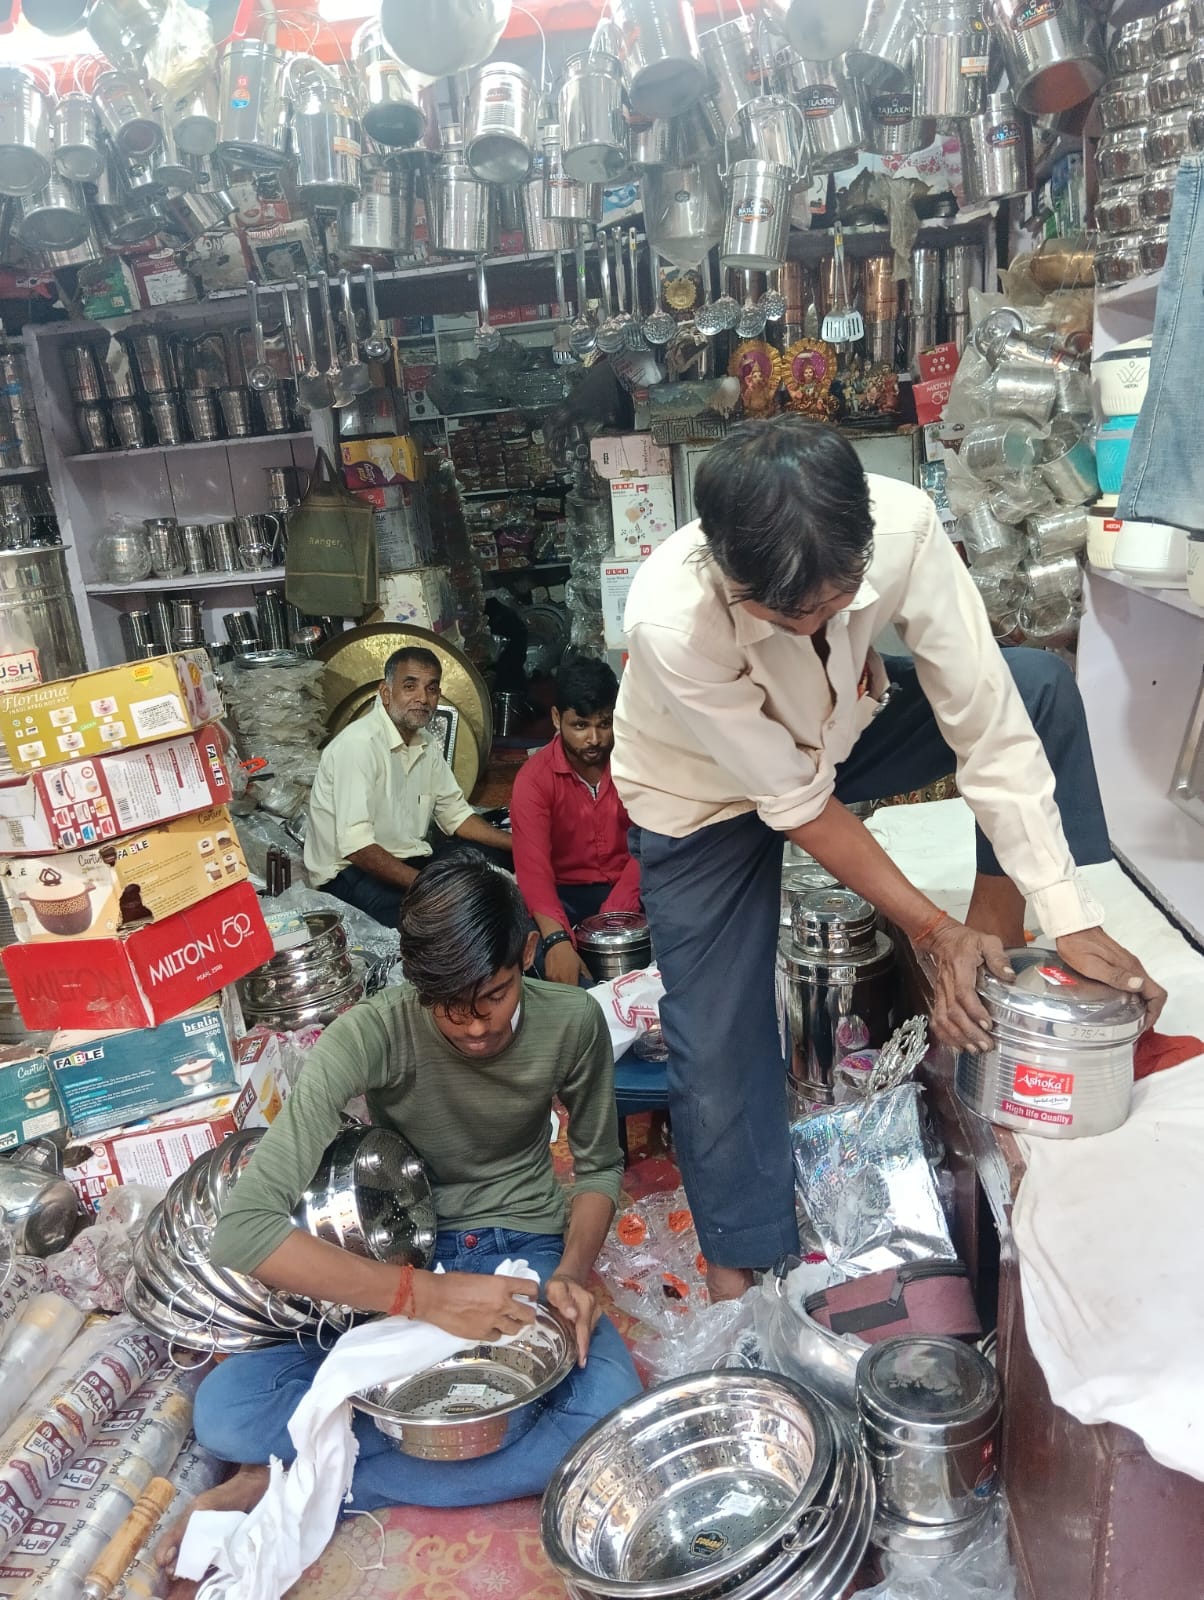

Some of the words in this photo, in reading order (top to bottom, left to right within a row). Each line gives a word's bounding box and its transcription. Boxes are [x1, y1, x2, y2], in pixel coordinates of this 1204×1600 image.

[2, 687, 68, 713] Floriana
[207, 744, 224, 786] FABLE
[148, 934, 215, 987] MILTON
[222, 913, 251, 948] 50
[55, 1050, 103, 1069] FABLE
[1017, 1073, 1063, 1090] Ashoka
[1005, 1102, 1024, 1117] High
[1040, 1112, 1070, 1125] Quality
[80, 1384, 103, 1412] Priya
[33, 1436, 59, 1464] Priya
[109, 1449, 133, 1475] Priya
[60, 1519, 86, 1547] Priya
